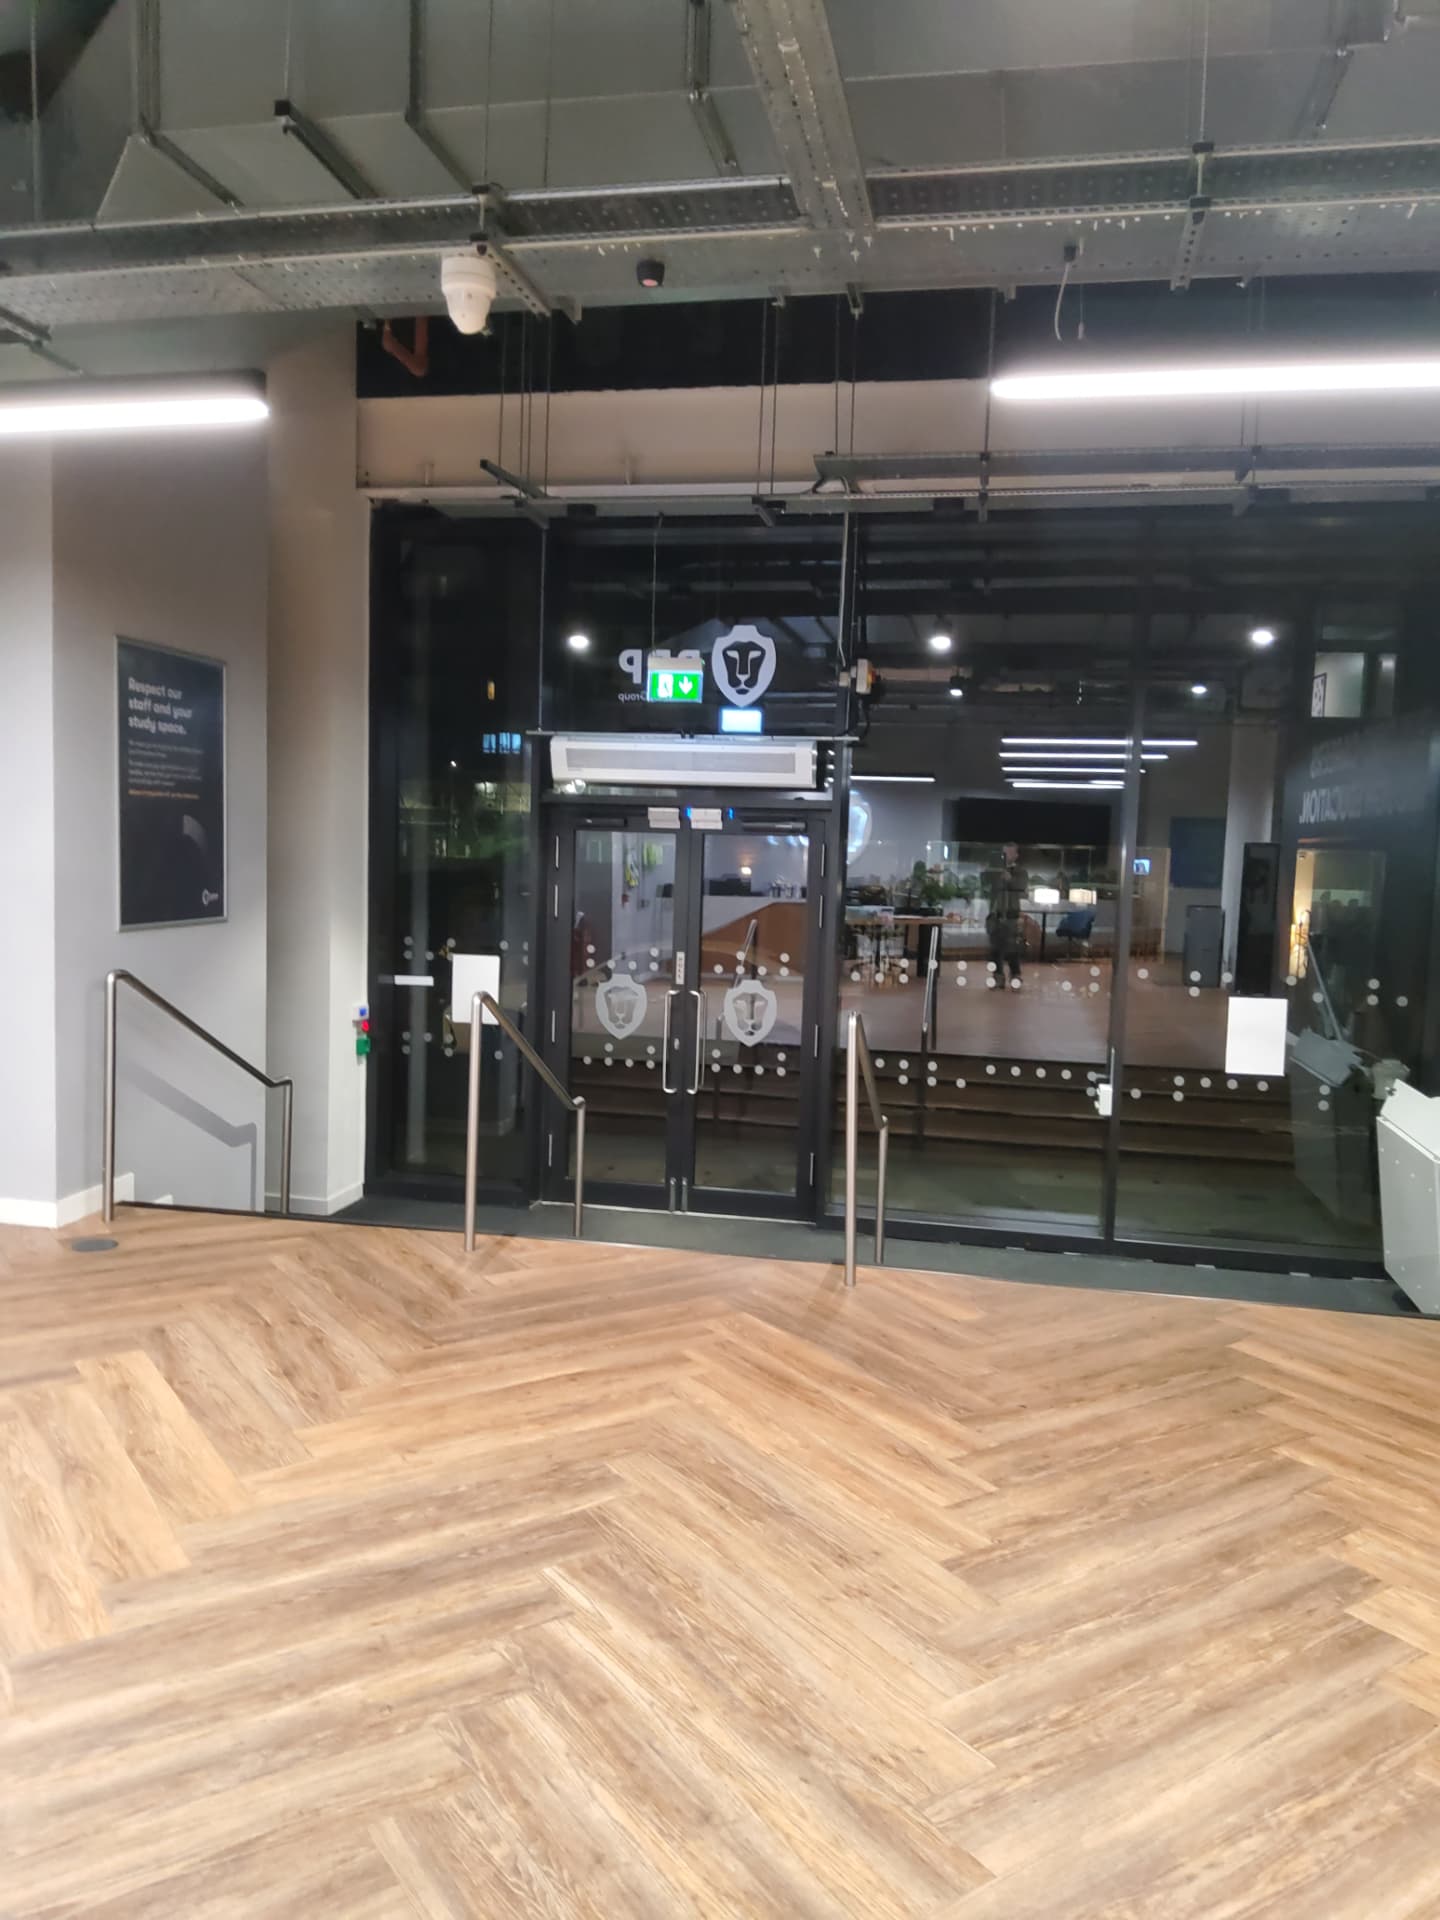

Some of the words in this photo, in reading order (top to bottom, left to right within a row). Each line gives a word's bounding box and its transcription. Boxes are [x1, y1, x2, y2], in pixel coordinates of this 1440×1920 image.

[128, 677, 166, 697] Respect
[167, 688, 183, 700] our
[128, 697, 152, 712] staff
[153, 702, 171, 715] and
[173, 706, 193, 720] your
[128, 715, 156, 734] study
[158, 720, 187, 736] space.
